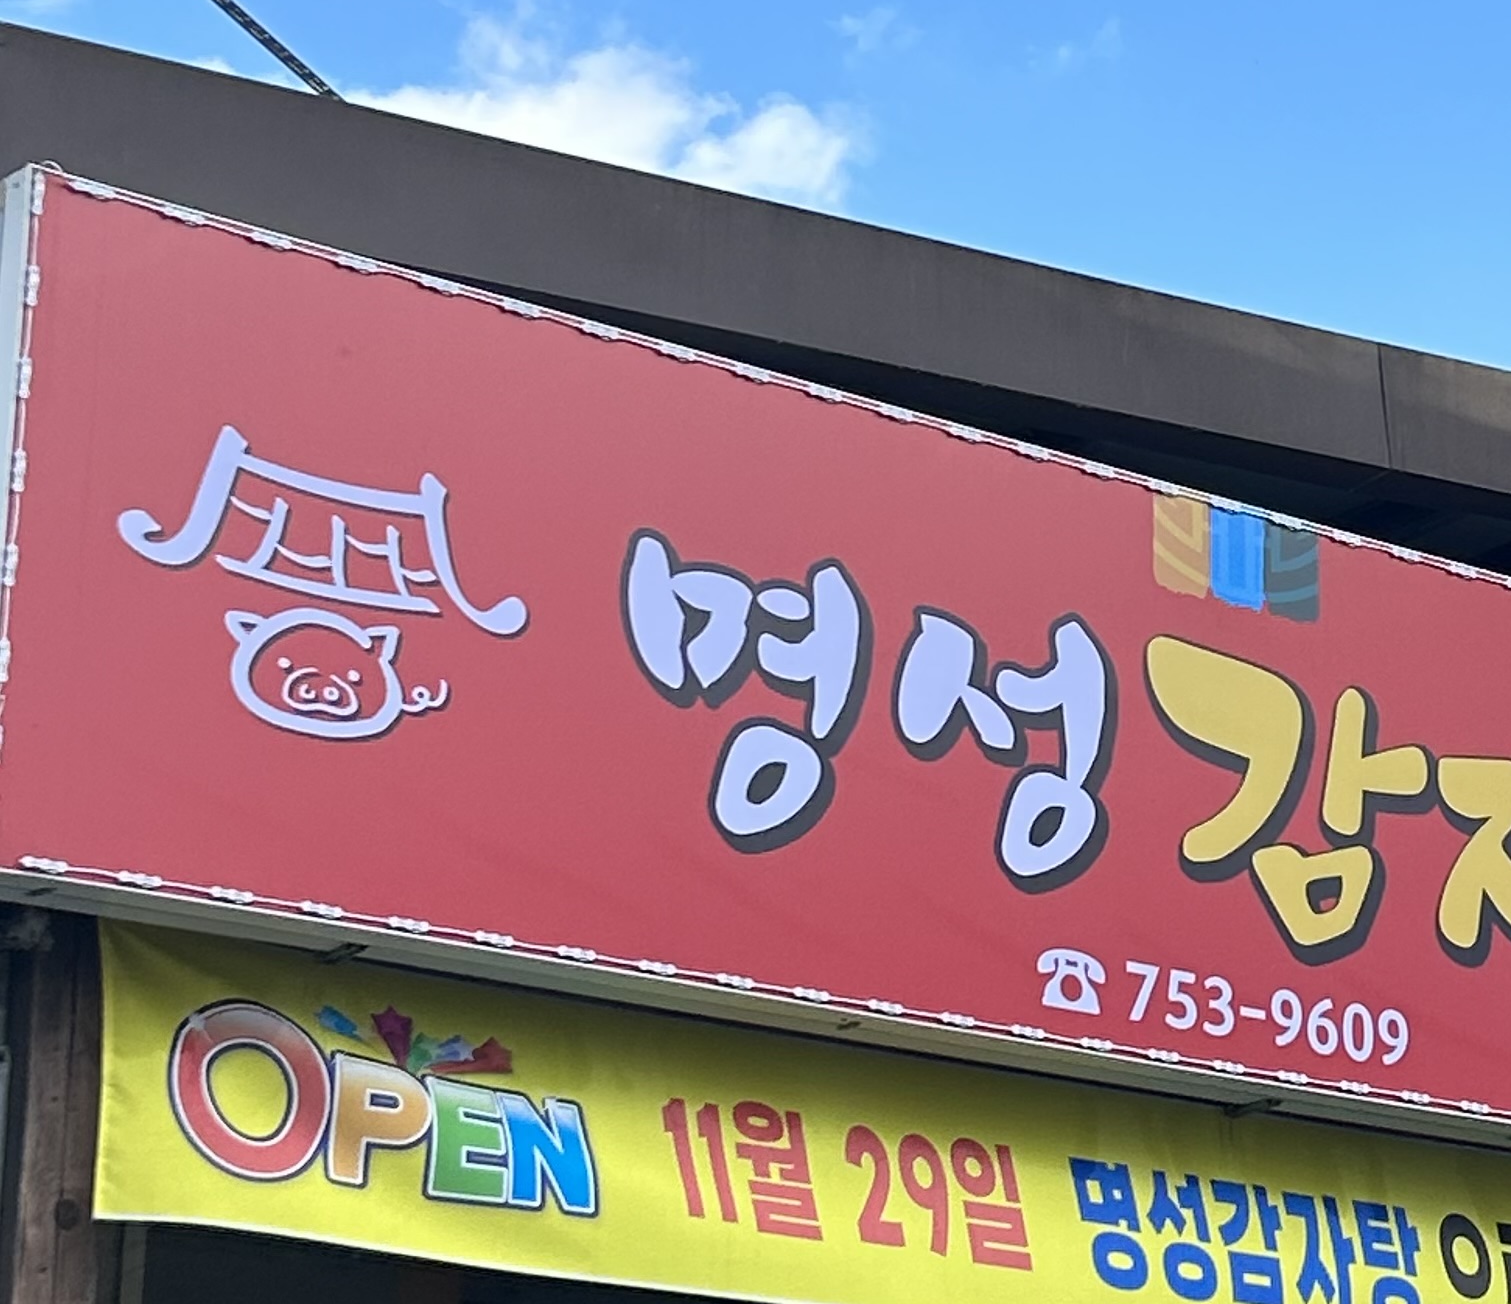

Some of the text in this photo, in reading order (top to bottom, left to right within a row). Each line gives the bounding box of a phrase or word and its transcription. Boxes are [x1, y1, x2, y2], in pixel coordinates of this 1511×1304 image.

[623, 528, 1112, 890] 명성
[167, 999, 600, 1218] OPEN
[662, 1098, 823, 1241] 11월
[845, 1123, 1032, 1271] 29일
[1124, 958, 1409, 1067] 753-9609
